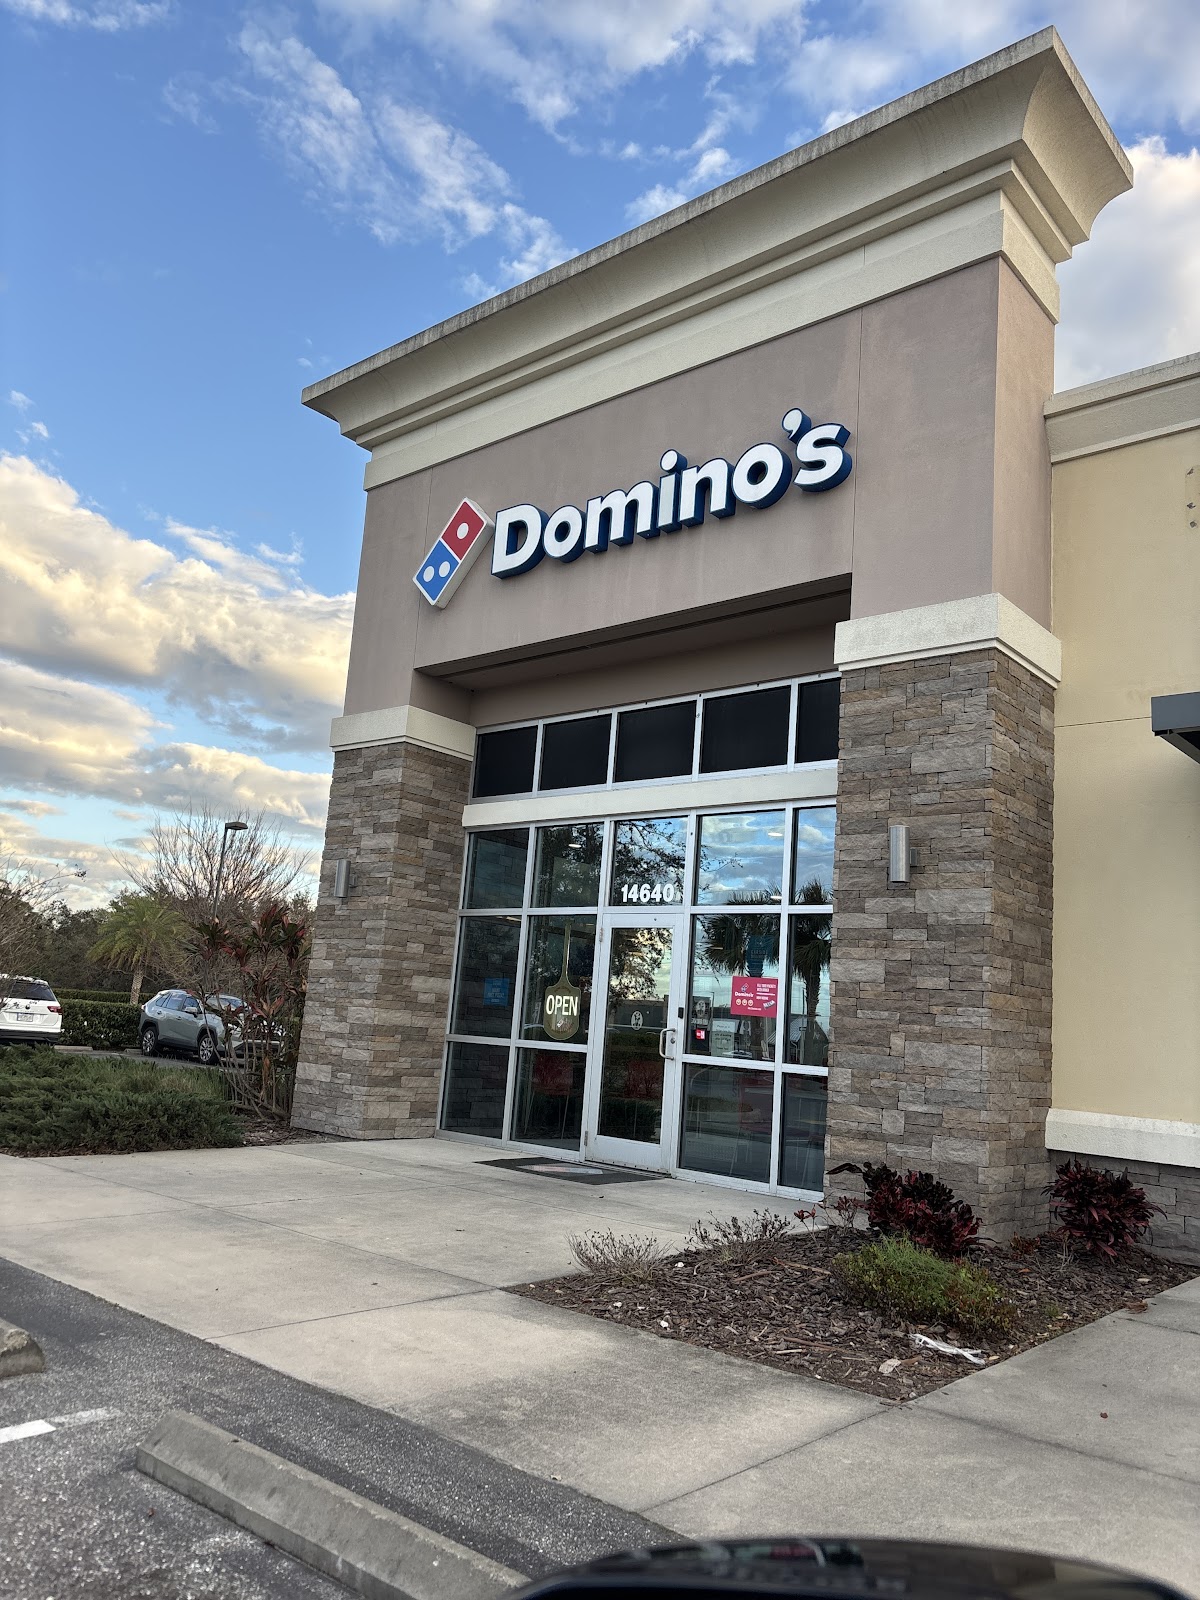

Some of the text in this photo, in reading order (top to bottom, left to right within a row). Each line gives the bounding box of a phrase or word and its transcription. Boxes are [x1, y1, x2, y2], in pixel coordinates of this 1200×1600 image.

[491, 407, 852, 578] Domino's
[621, 883, 675, 903] 14640
[546, 994, 578, 1016] OPEN
